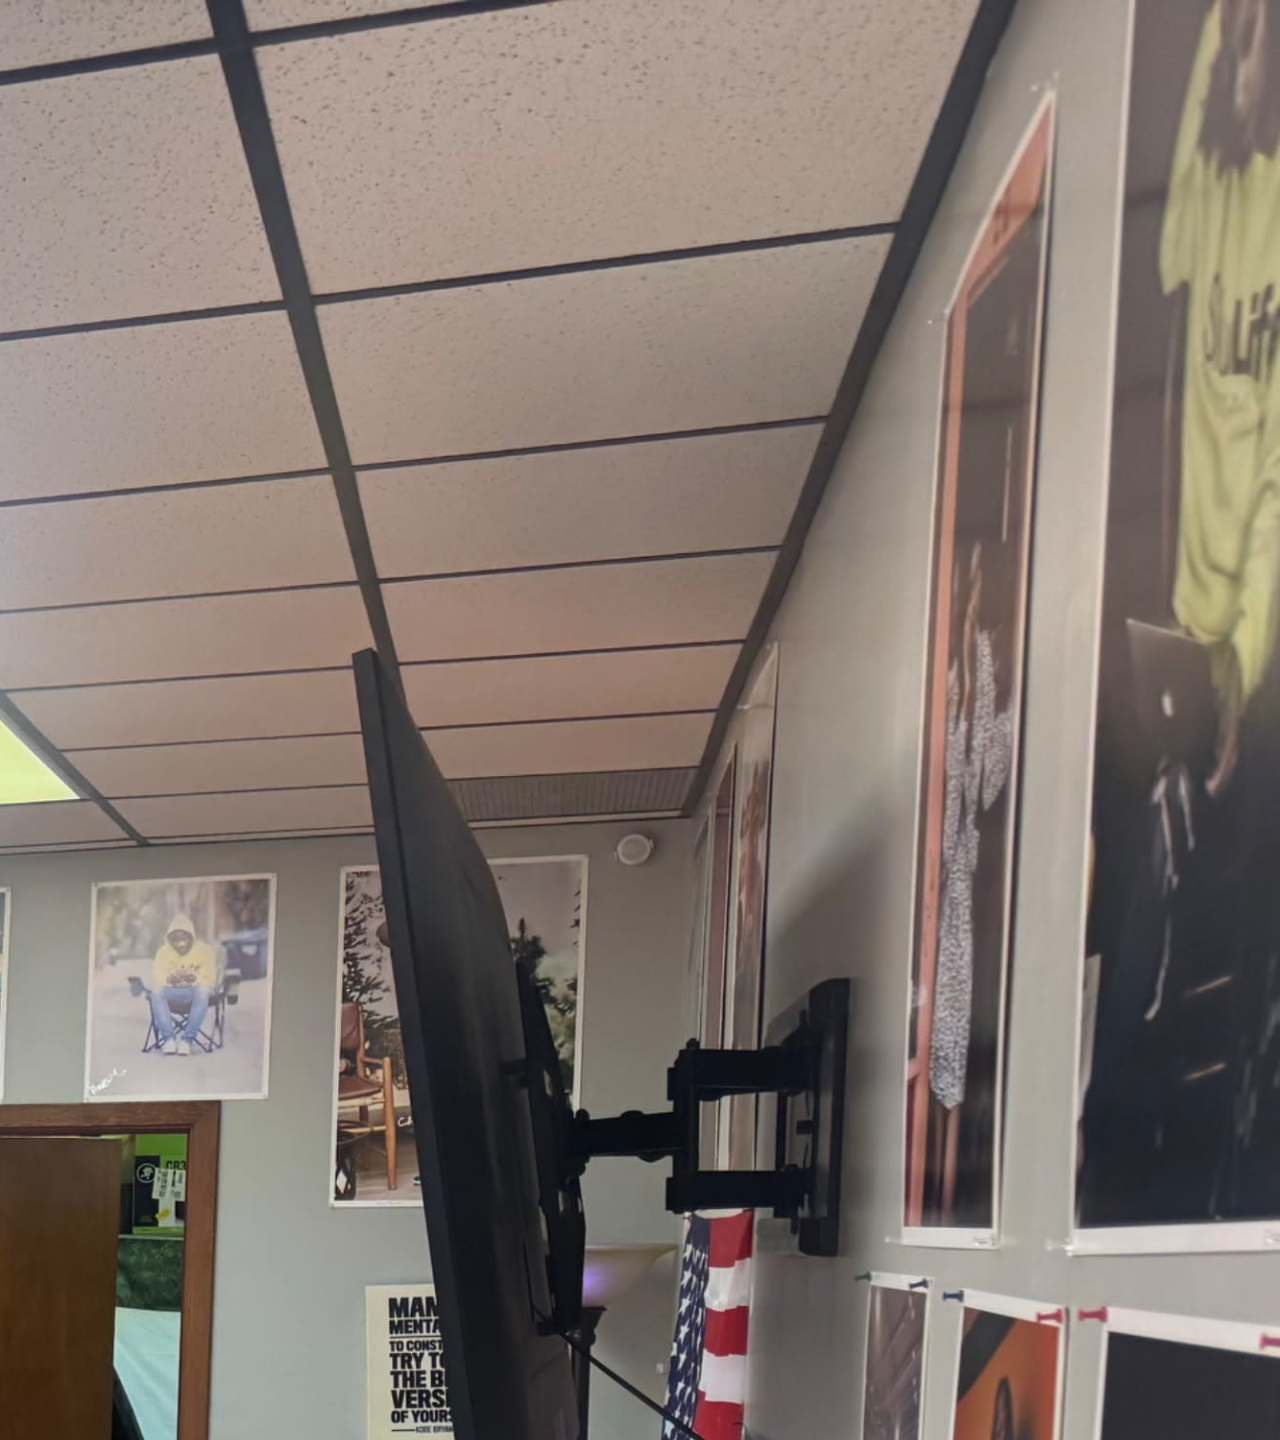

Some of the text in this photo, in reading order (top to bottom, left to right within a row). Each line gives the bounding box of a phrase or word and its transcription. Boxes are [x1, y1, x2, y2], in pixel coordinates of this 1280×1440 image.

[390, 1340, 404, 1351] TO
[390, 1353, 425, 1369] TRY
[390, 1371, 426, 1388] THE
[391, 1410, 408, 1423] OF
